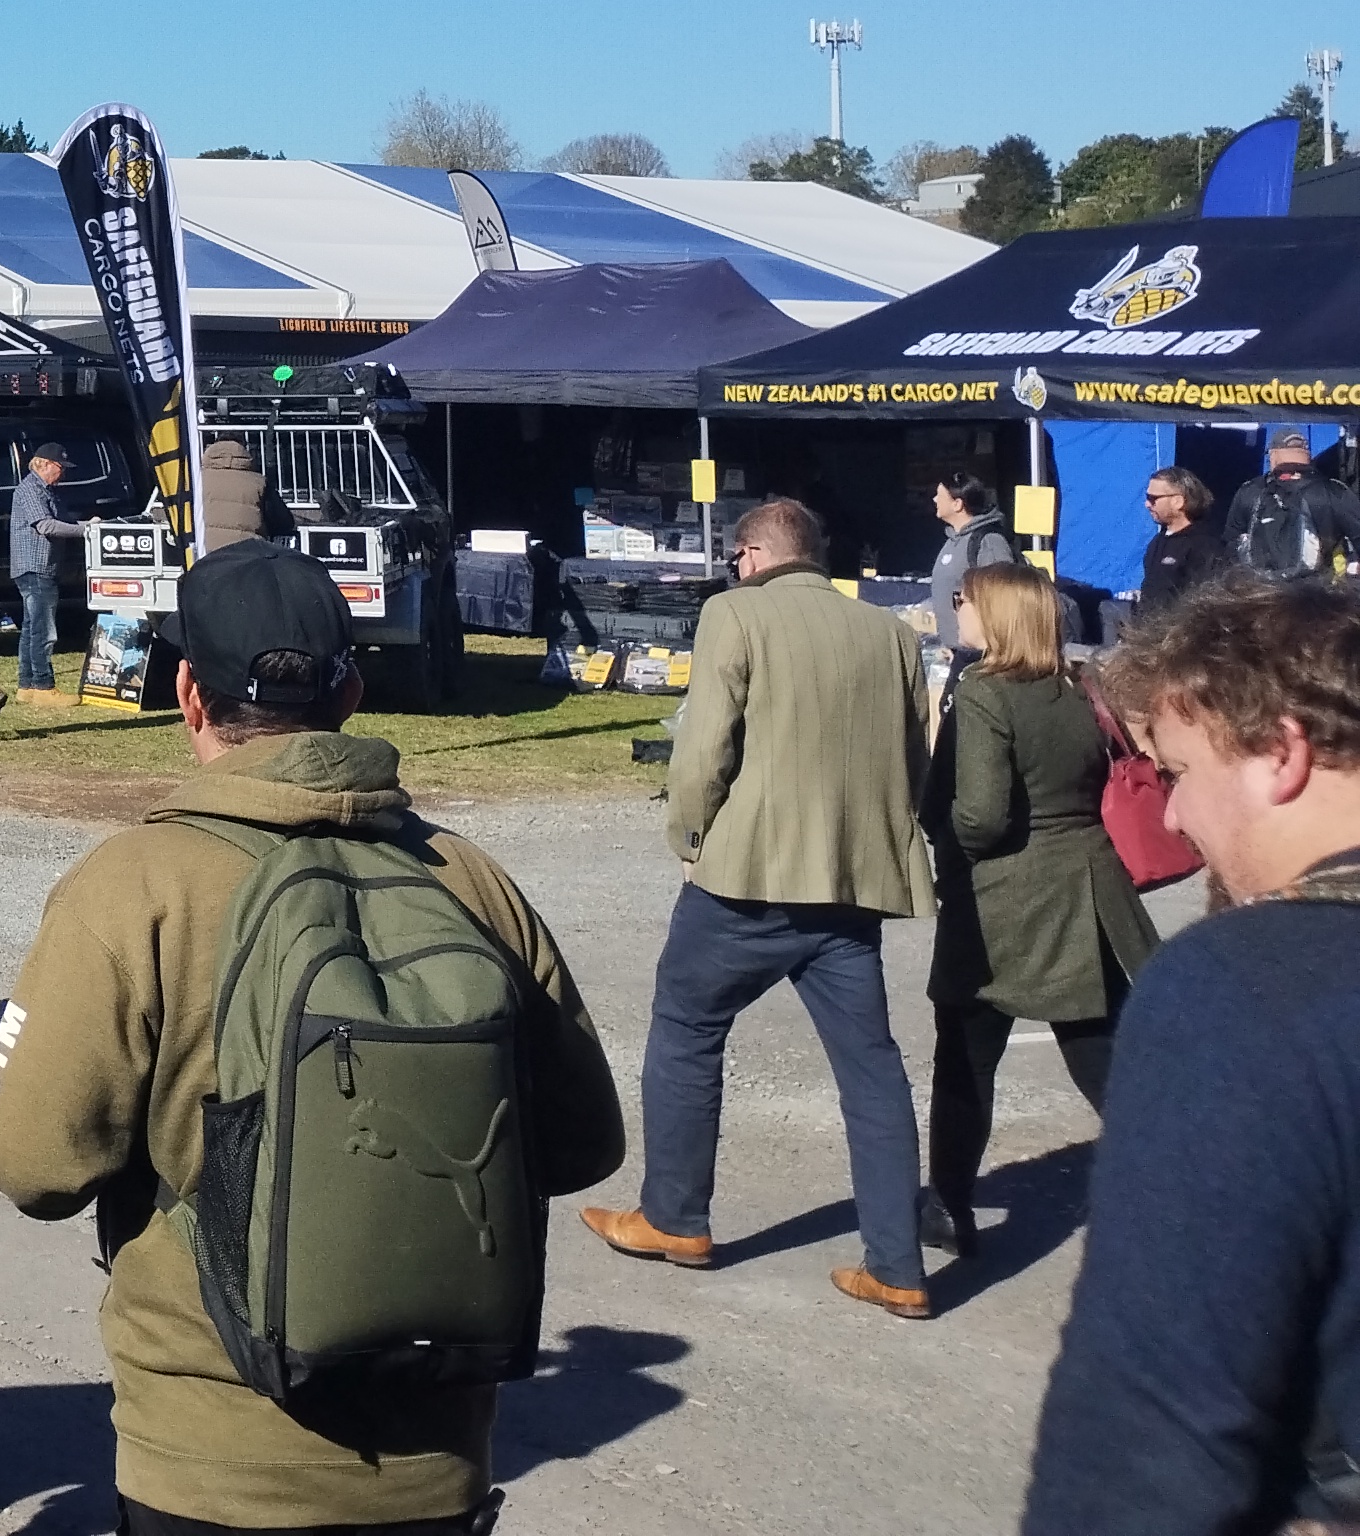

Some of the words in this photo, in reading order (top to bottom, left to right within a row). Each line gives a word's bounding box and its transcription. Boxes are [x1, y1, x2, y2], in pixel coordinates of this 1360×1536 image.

[84, 218, 123, 312] CARGO
[114, 317, 145, 384] NETS
[102, 206, 180, 383] SAFEGUARD
[279, 318, 327, 331] LICHFIELD
[330, 319, 378, 333] LIFESTYLE
[381, 321, 409, 334] SHEDS
[903, 329, 1080, 356] SAFEGUARD
[1062, 330, 1182, 356] CARGO
[1164, 329, 1261, 357] NETS
[723, 385, 764, 402] NEW
[767, 383, 865, 403] ZEALAND'S
[866, 383, 887, 402] #1
[891, 383, 956, 403] CARGO
[960, 381, 999, 402] NET
[1074, 378, 1360, 409] www.safeguardnet.co
